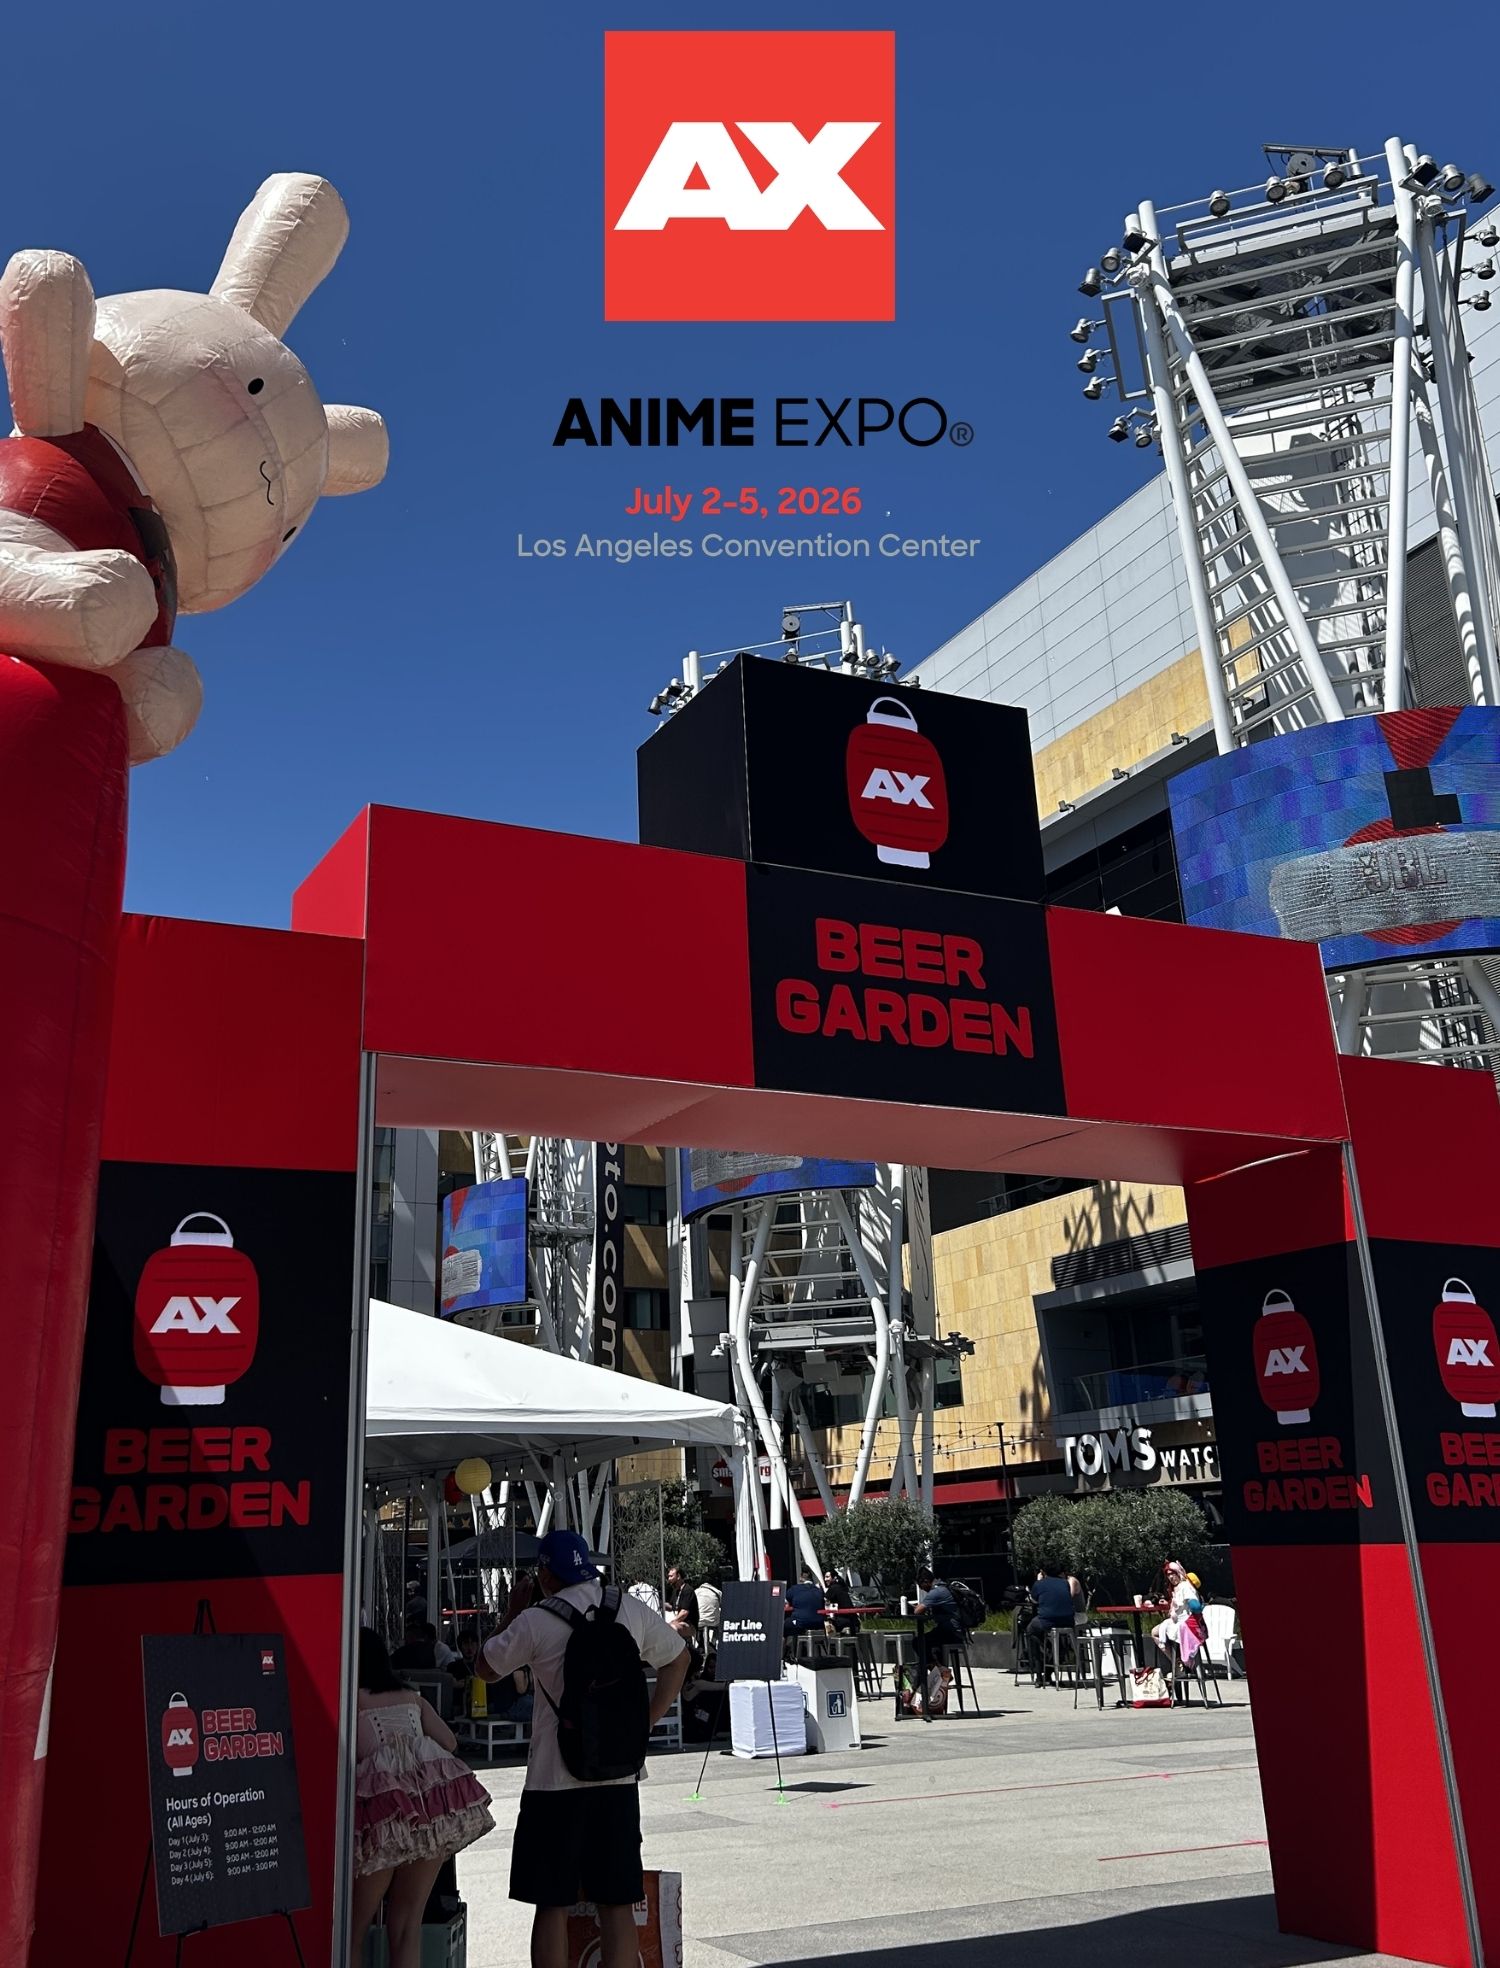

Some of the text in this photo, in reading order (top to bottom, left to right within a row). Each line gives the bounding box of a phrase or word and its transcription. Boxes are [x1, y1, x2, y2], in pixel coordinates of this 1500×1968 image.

[861, 768, 934, 810] AX
[815, 917, 986, 989] BEER
[775, 978, 1034, 1058] GARDEN
[149, 1296, 242, 1334] AX
[1264, 1345, 1310, 1377] AX
[1446, 1338, 1494, 1367] AX
[104, 1426, 272, 1475] BEER
[1160, 1445, 1216, 1467] WATC
[1257, 1436, 1344, 1473] BEER
[1243, 1474, 1374, 1512] GARDEN
[67, 1480, 311, 1533] GARDEN
[573, 1550, 583, 1566] LA
[723, 1619, 762, 1630] Bar Line
[722, 1632, 766, 1642] Entrance
[202, 1708, 257, 1734] BEER
[167, 1728, 194, 1746] AX
[204, 1732, 283, 1761] GARDEN
[166, 1788, 265, 1811] Hours of Operation
[167, 1812, 212, 1831] (All Ages)
[267, 1824, 276, 1832] AM
[168, 1838, 181, 1846] Day
[186, 1834, 200, 1846] (July
[239, 1840, 249, 1848] AM
[268, 1836, 278, 1844] AM
[169, 1850, 181, 1859] Day
[188, 1847, 202, 1857] (July
[240, 1852, 250, 1861] AM
[269, 1848, 279, 1856] AM
[170, 1863, 182, 1872] Day
[189, 1859, 203, 1870] (July
[241, 1865, 251, 1873] AM
[171, 1876, 184, 1885] Day
[189, 1872, 205, 1883] (July
